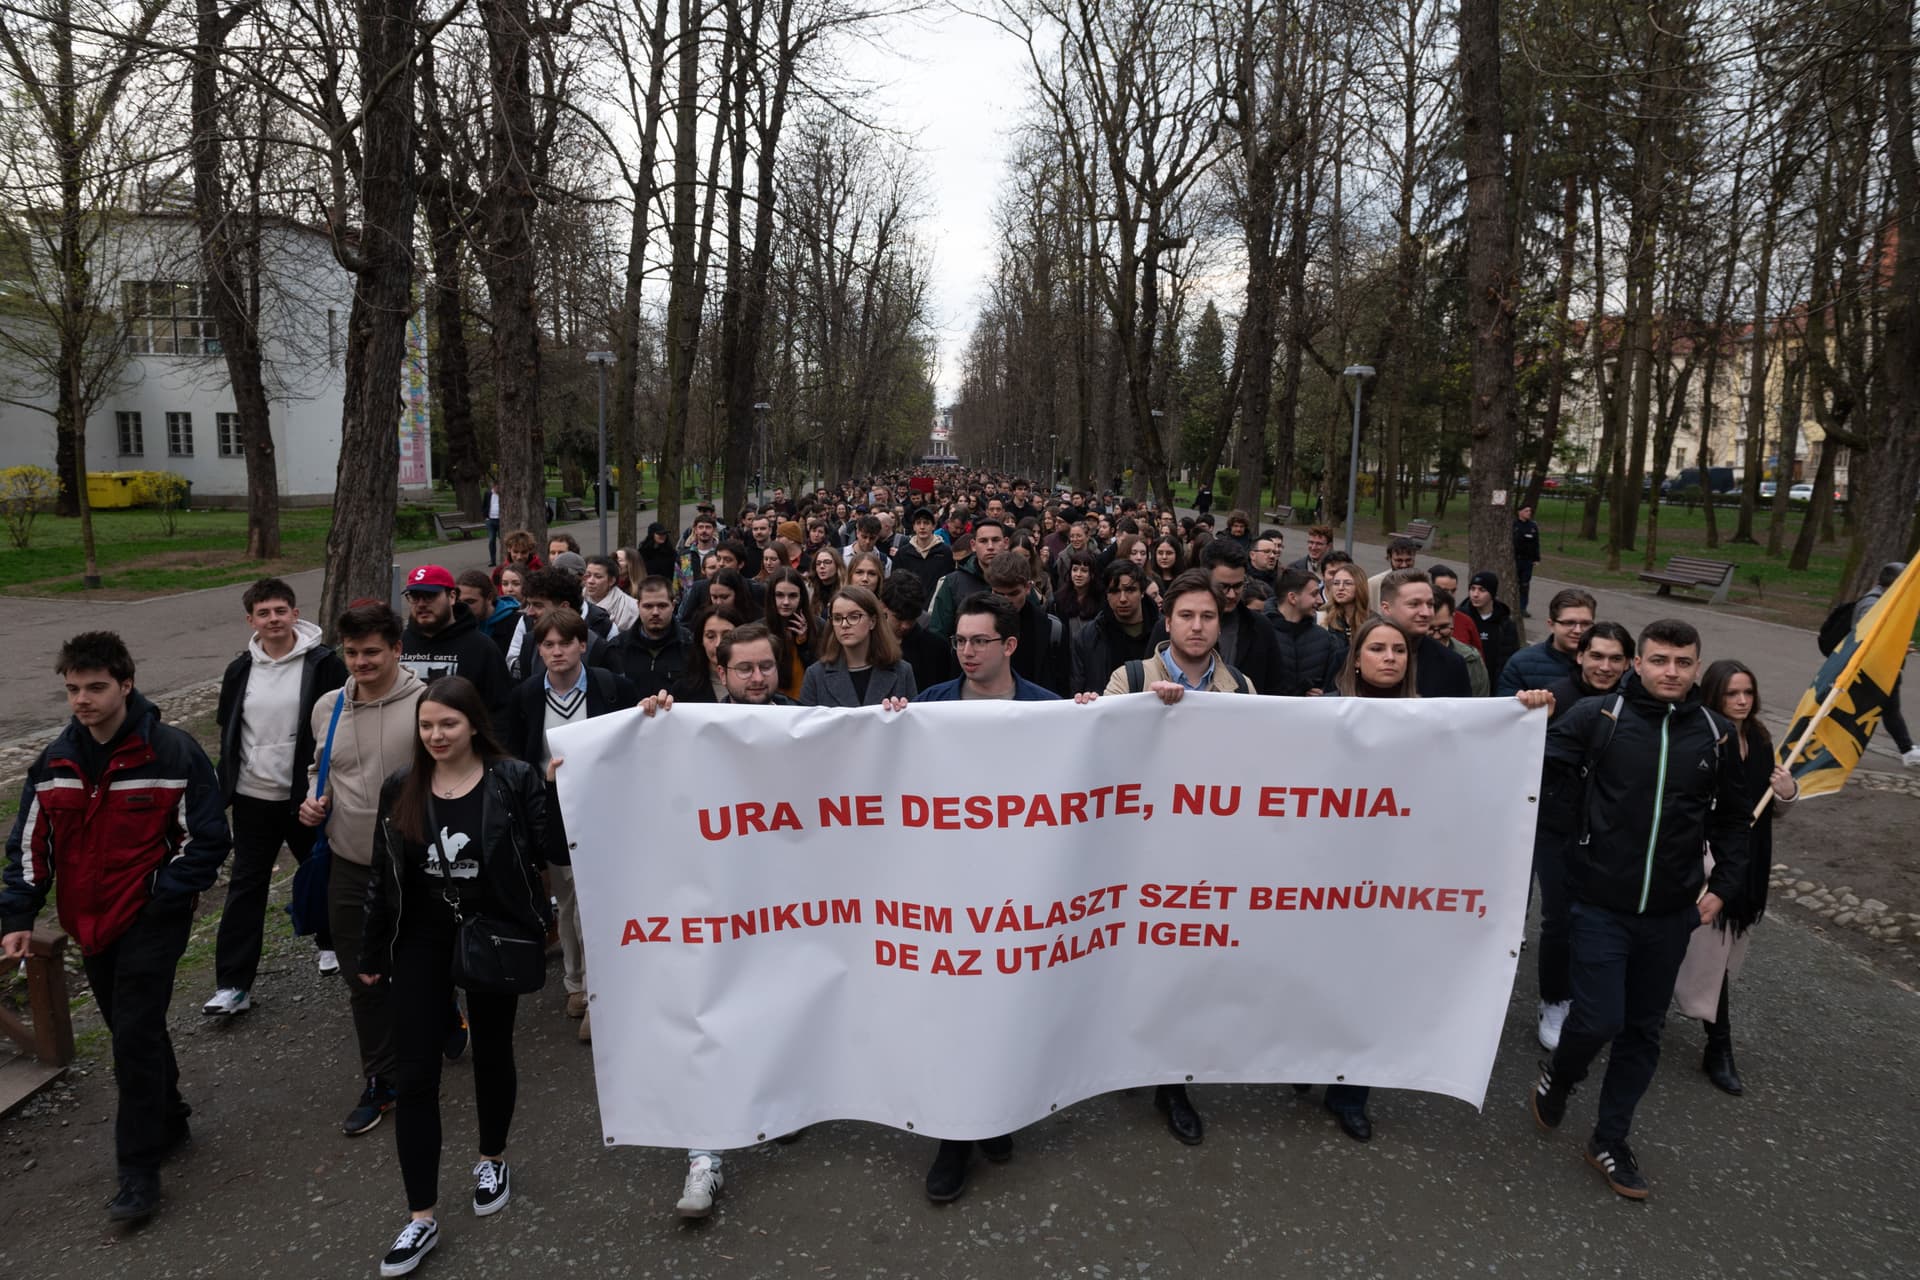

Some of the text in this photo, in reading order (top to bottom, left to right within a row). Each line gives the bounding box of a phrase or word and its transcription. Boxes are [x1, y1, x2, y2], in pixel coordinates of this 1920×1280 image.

[414, 568, 427, 581] S
[699, 784, 1412, 841] URA NE DESPARTE, NU ETNIA.
[621, 881, 1488, 946] AZ ETNIKUM NEM VÁLASZT SZÉT BENNÜNKET,
[875, 922, 1240, 977] DE AZ UTÁLAT IGEN.
